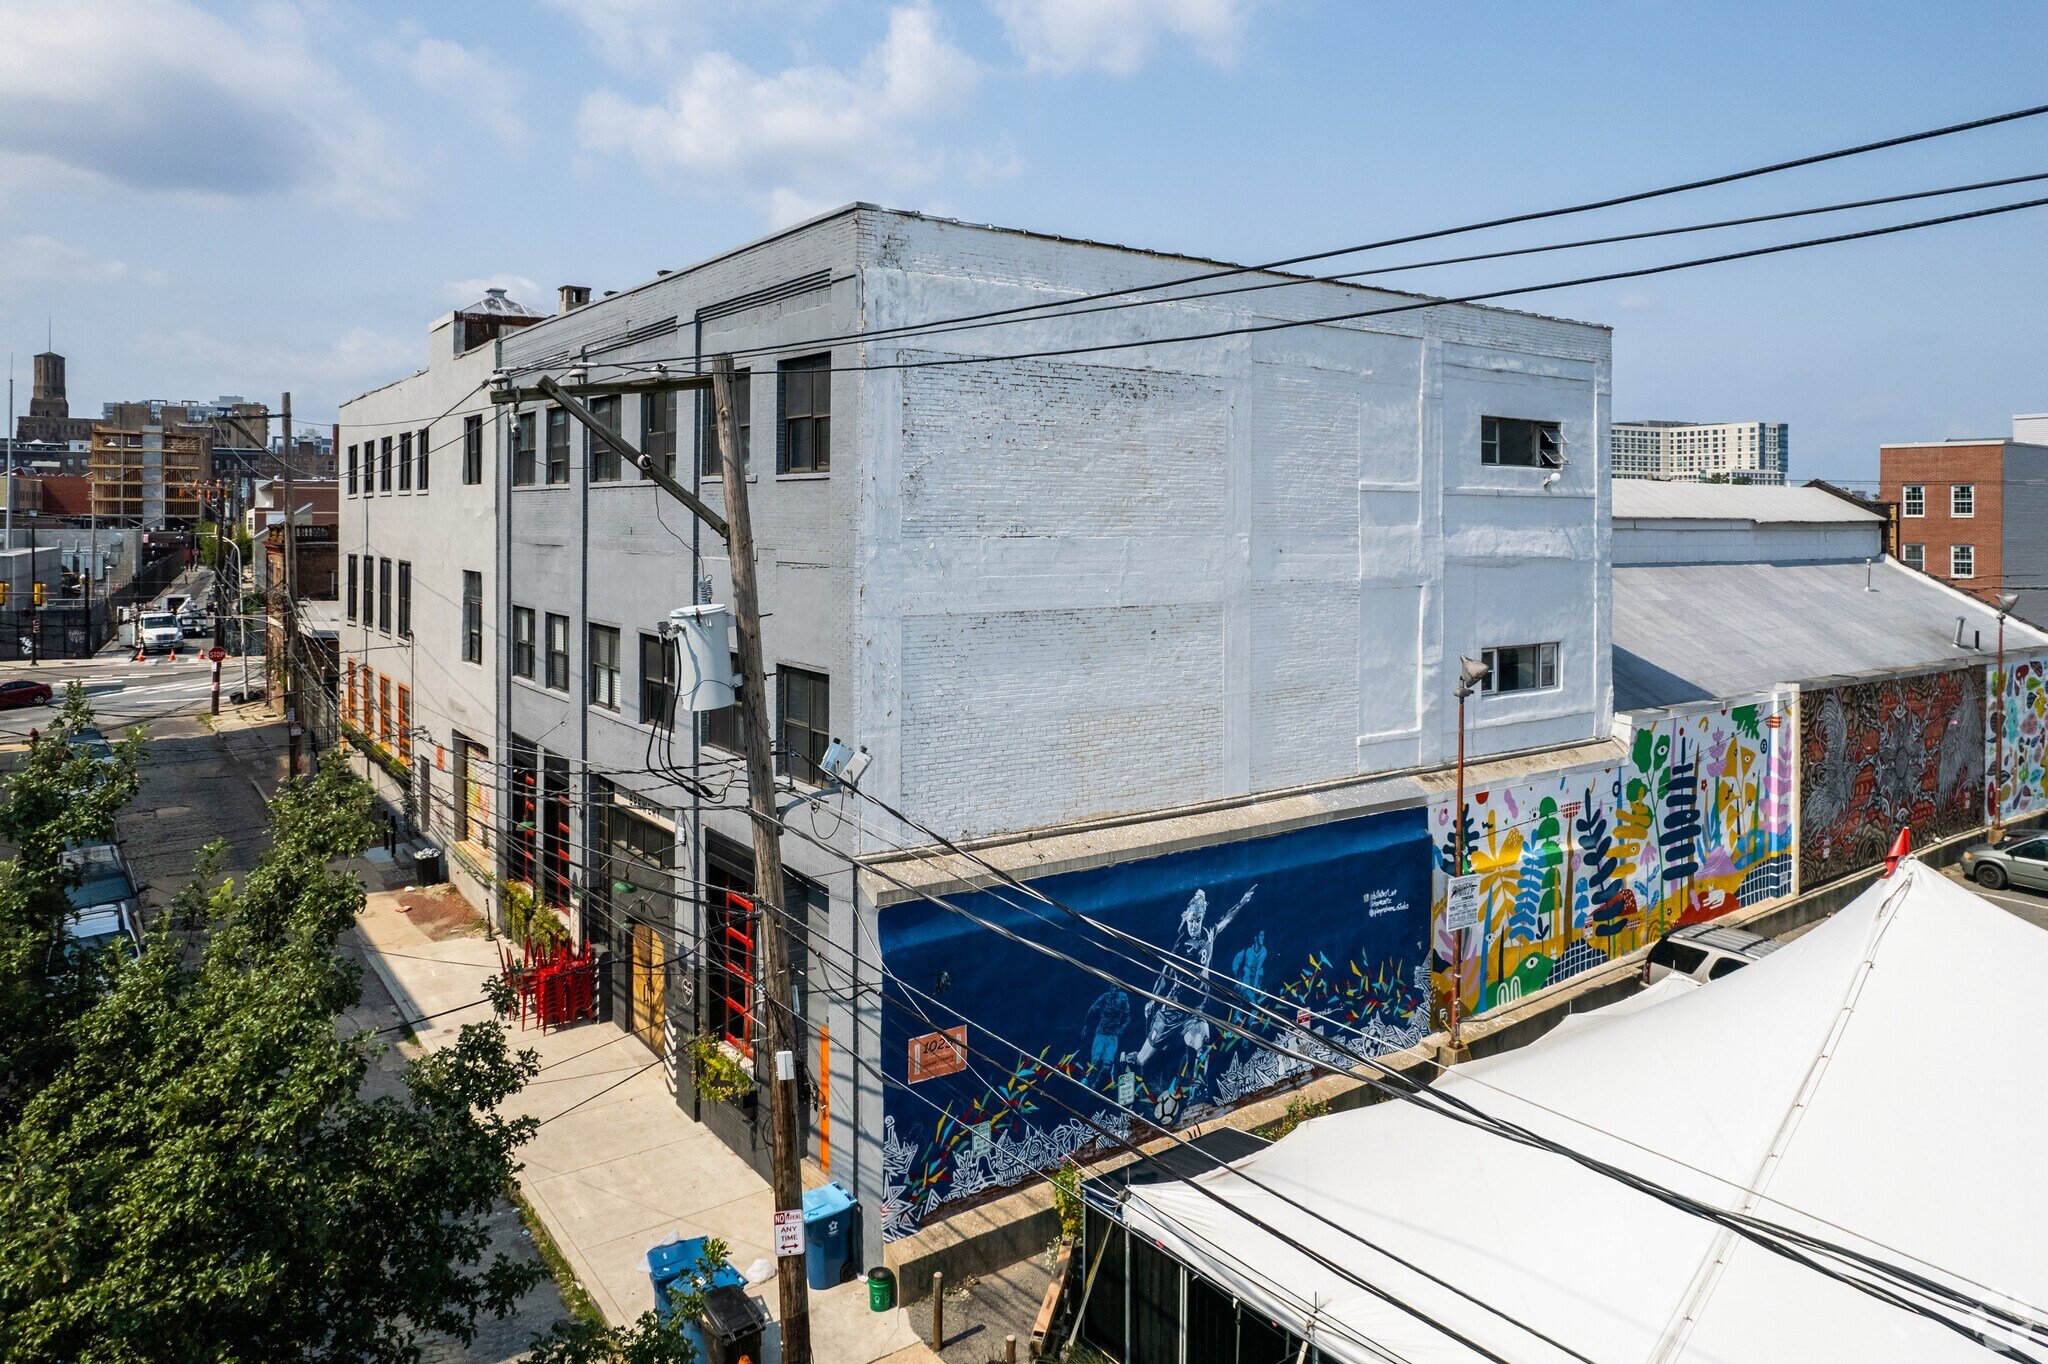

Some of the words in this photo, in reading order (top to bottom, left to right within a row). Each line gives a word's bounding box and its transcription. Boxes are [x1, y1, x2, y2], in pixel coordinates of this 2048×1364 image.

[1200, 948, 1208, 965] 8
[775, 1213, 785, 1224] NO
[780, 1234, 798, 1242] TIME
